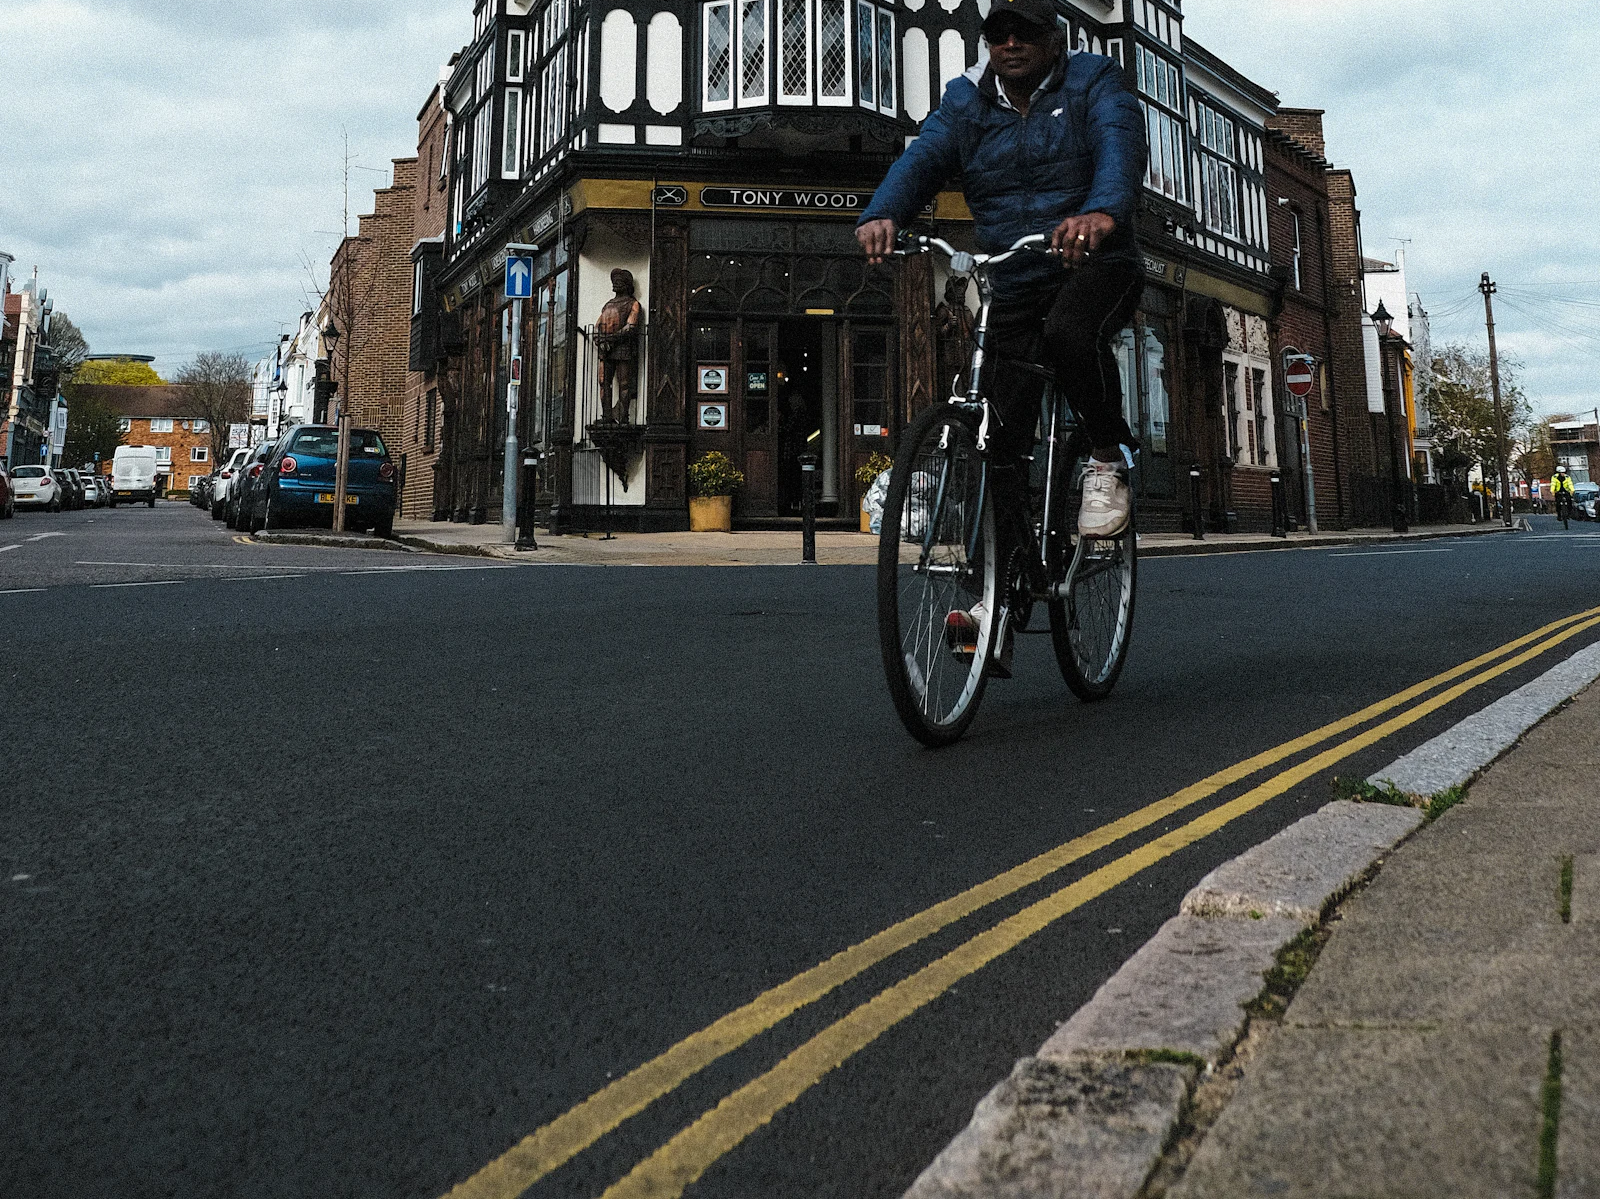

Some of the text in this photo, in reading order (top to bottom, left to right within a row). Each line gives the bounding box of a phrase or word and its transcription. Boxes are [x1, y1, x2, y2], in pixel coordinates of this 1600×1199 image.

[730, 190, 858, 207] TONY WOOD
[1143, 257, 1165, 274] PECIALIST
